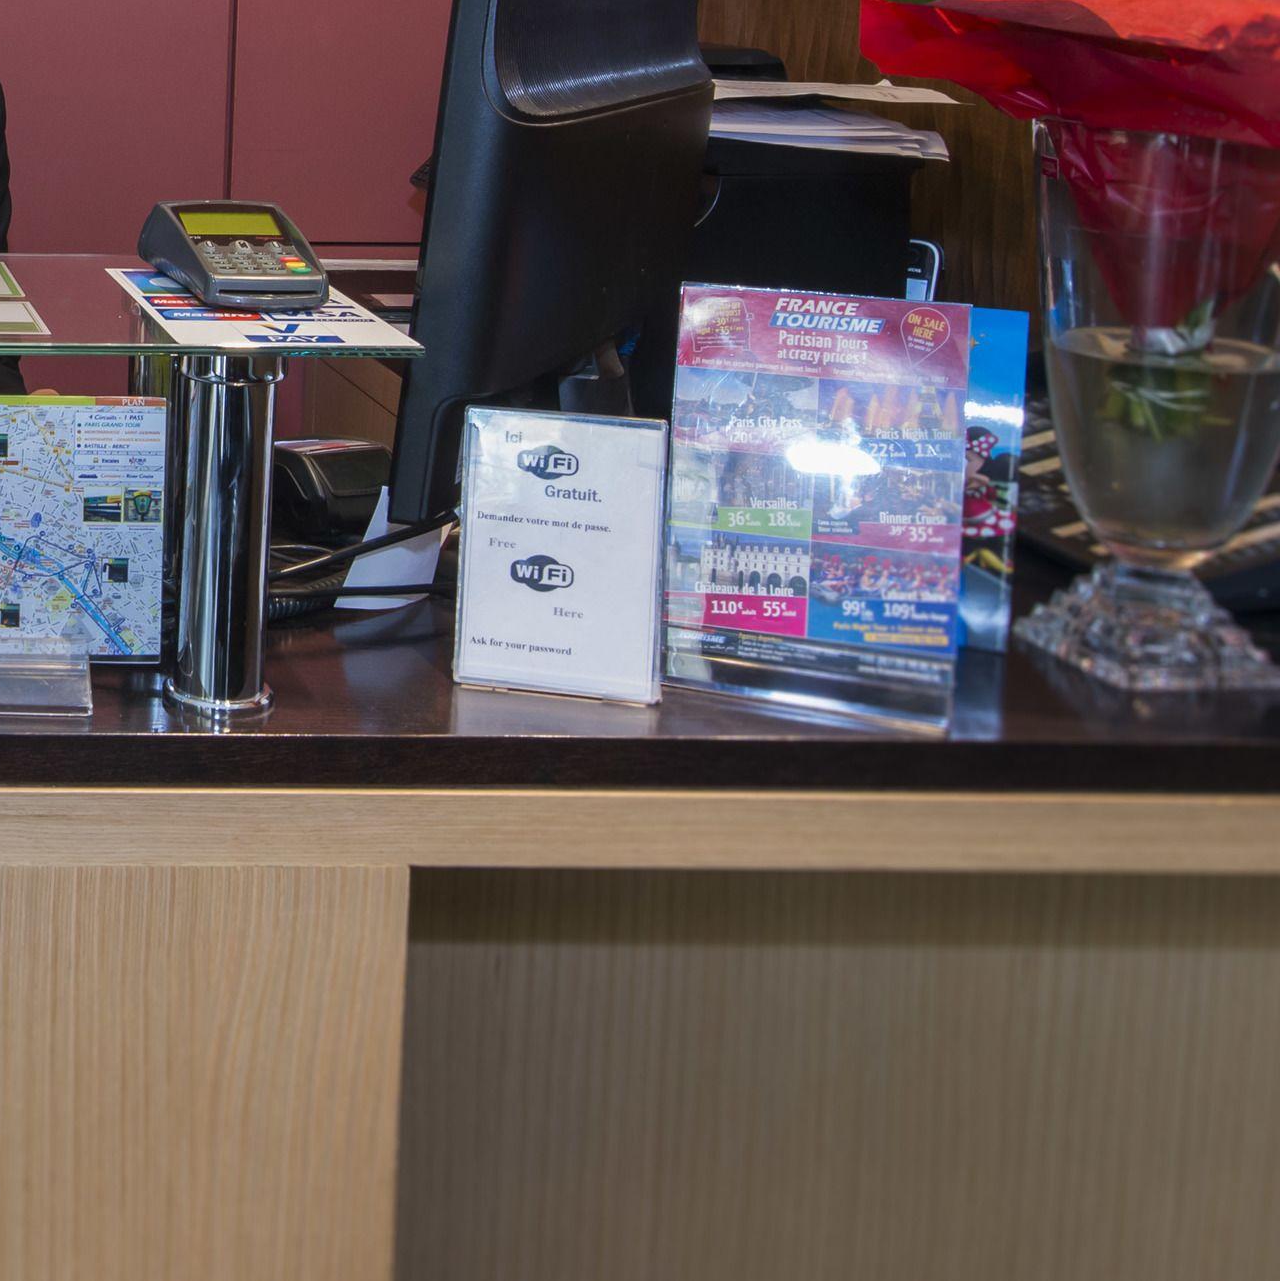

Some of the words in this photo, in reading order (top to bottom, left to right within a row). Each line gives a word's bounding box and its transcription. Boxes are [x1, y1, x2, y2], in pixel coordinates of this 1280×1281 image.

[172, 310, 254, 318] Maestro
[775, 297, 860, 317] FRANCE
[774, 312, 885, 334] TOURISME
[907, 313, 923, 326] ON
[923, 317, 946, 332] SALE
[778, 330, 833, 349] Parisian
[835, 332, 869, 352] Tours
[912, 325, 936, 341] HERE
[777, 348, 787, 359] at
[788, 349, 821, 364] crazy
[823, 351, 860, 365] prices
[121, 398, 146, 407] PLAN
[729, 415, 755, 428] Paris
[757, 416, 778, 430] City
[504, 430, 524, 444] Ici
[875, 427, 900, 439] Paris
[901, 427, 929, 443] Night
[931, 428, 953, 440] Tour
[544, 484, 603, 504] Gratuit.
[749, 496, 799, 511] Versailles
[477, 510, 524, 524] Demandez
[526, 515, 549, 527] votre
[551, 518, 569, 529] mot
[571, 520, 583, 530] de
[584, 522, 612, 534] passe.
[726, 512, 752, 528] 36€
[879, 511, 913, 525] Dinner
[908, 525, 934, 542] 35€
[488, 536, 518, 549] Free
[694, 580, 740, 595] Châteaux
[741, 582, 755, 595] de
[756, 583, 768, 595] la
[769, 584, 794, 597] Loire
[553, 606, 585, 620] Here
[710, 599, 744, 615] 110€
[761, 600, 788, 616] 55€
[842, 599, 867, 616] 99€
[469, 635, 488, 646] Ask
[488, 637, 503, 648] for
[503, 640, 527, 651] your
[528, 643, 573, 656] password
